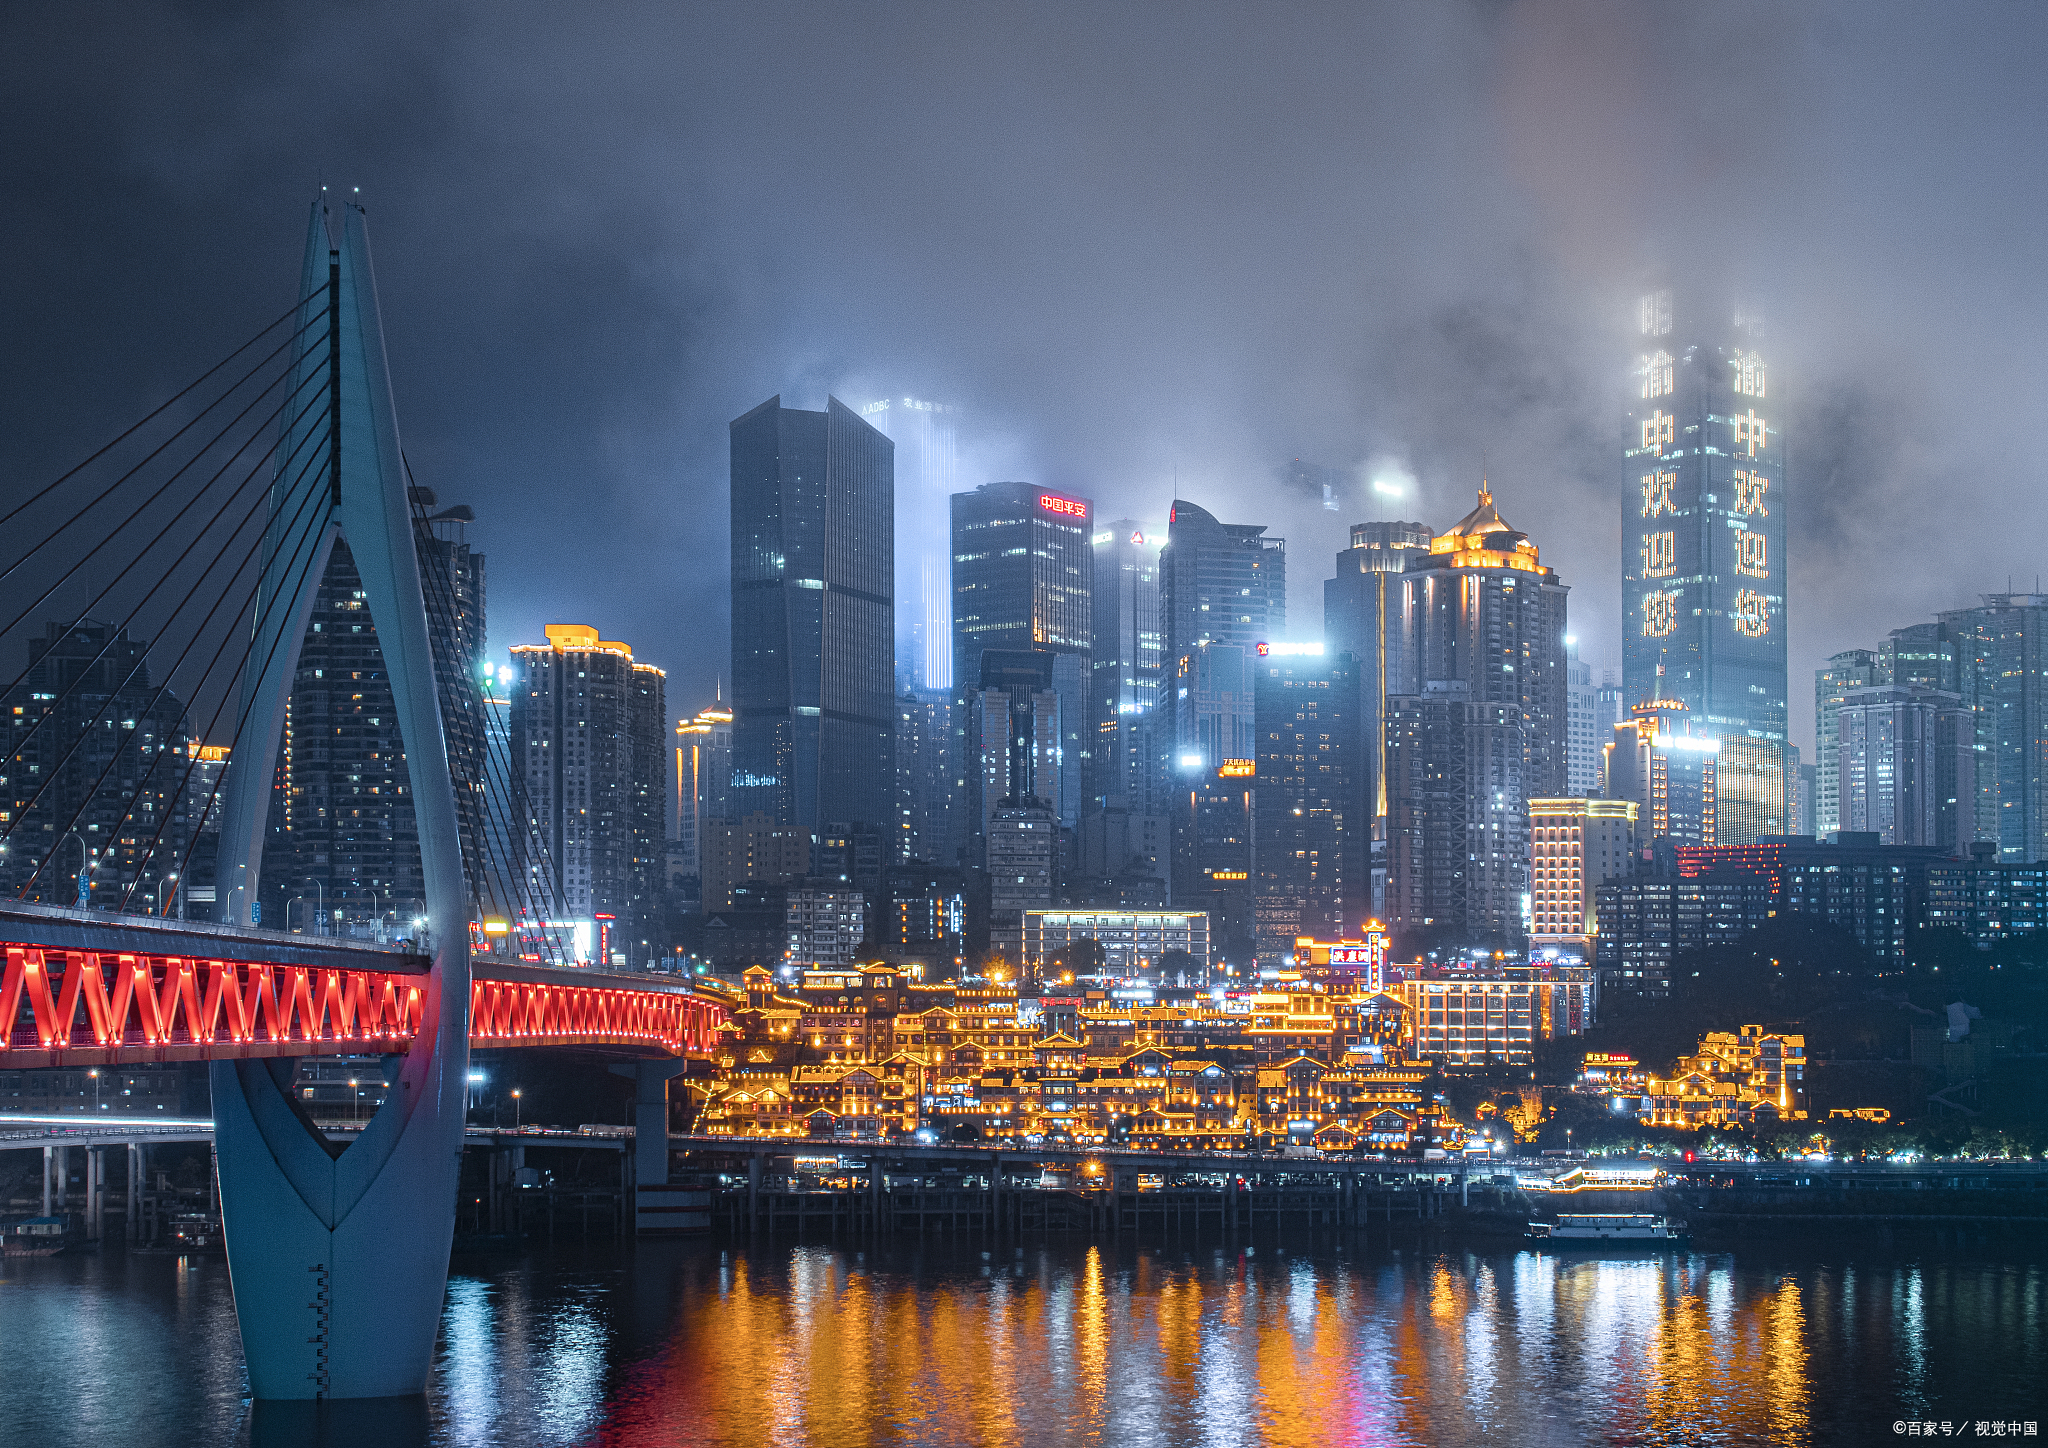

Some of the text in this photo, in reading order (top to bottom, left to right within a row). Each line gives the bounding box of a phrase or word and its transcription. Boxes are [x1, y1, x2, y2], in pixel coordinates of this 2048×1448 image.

[867, 399, 890, 414] ADBC
[1040, 495, 1086, 518] 中国平安
[1334, 949, 1369, 963] 洪崖洞
